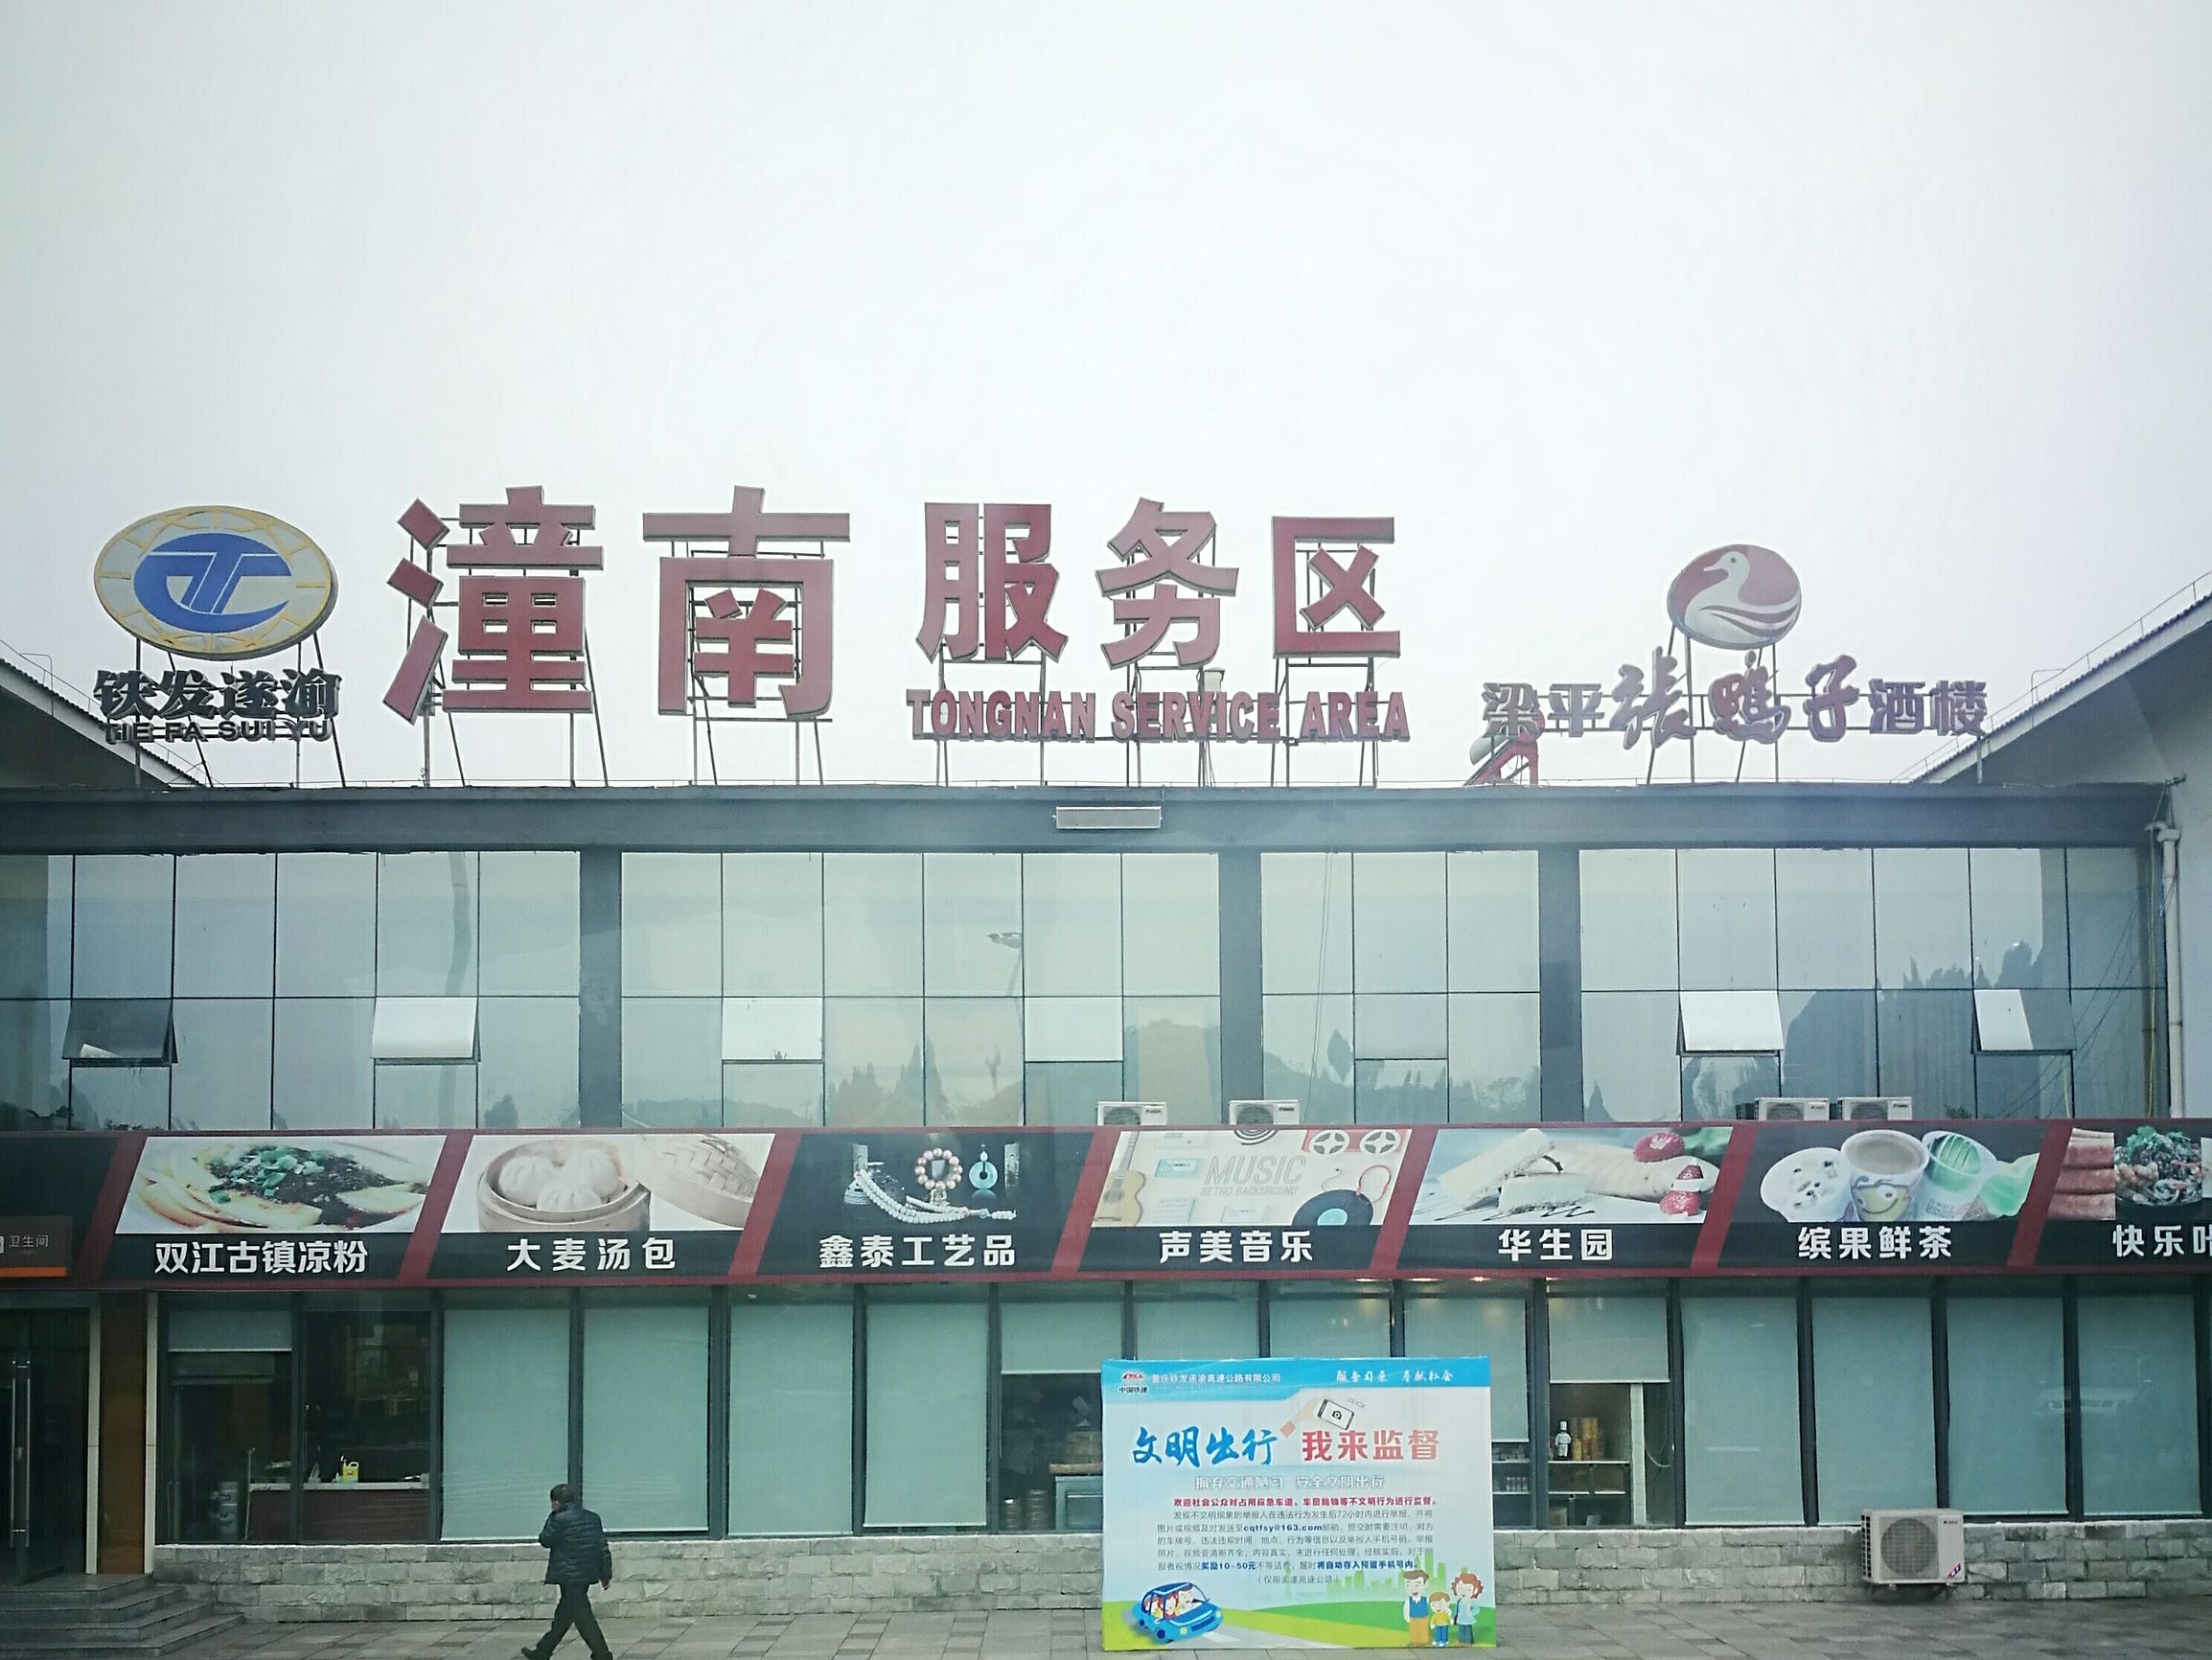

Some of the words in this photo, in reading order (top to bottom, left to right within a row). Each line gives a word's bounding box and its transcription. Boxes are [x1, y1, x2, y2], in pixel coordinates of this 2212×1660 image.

[382, 485, 1401, 726] 潼南服务区
[94, 668, 343, 721] 铁发遂渝
[104, 721, 155, 745] TIE
[165, 720, 208, 743] FA
[219, 719, 277, 743] SUI
[288, 719, 334, 743] YU
[906, 688, 1095, 743] TONGNAN
[1110, 690, 1281, 744] SERVICE
[1300, 691, 1411, 744] AREA
[1204, 1155, 1307, 1186] MUSIC
[9, 1234, 50, 1248] 卫生间
[154, 1241, 369, 1275] 双江古镇凉粉
[506, 1237, 677, 1272] 大麦汤包
[819, 1233, 1016, 1269] 鑫泰工艺品
[1159, 1230, 1313, 1264] 声美音乐
[1498, 1228, 1613, 1261] 华生园
[1797, 1227, 1952, 1260] 缤果鲜茶
[1132, 1425, 1279, 1468] 文明出行
[1302, 1429, 1440, 1463] 我来监督
